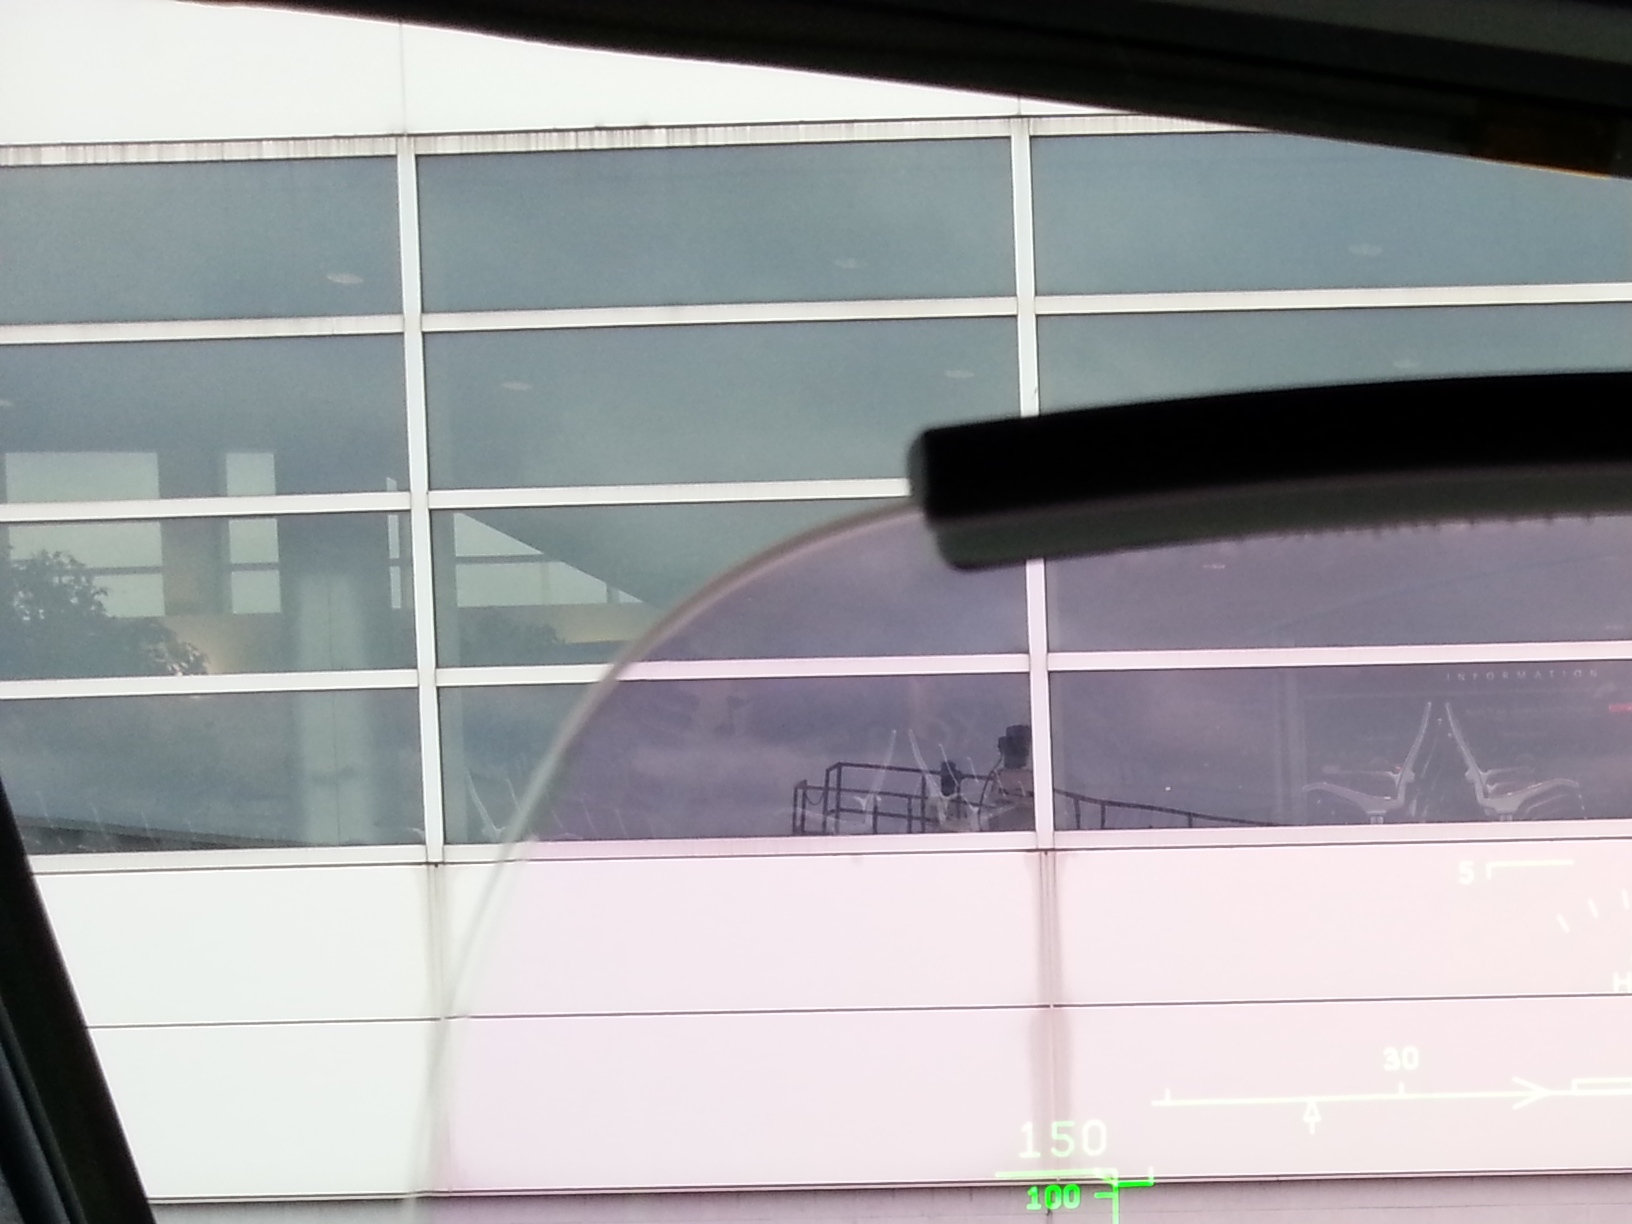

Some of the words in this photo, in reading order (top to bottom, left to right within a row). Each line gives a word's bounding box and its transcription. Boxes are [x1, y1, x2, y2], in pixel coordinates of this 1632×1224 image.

[1459, 859, 1475, 885] 5
[1383, 1045, 1420, 1071] 30
[1018, 1119, 1108, 1159] 150
[1026, 1184, 1081, 1211] 100
